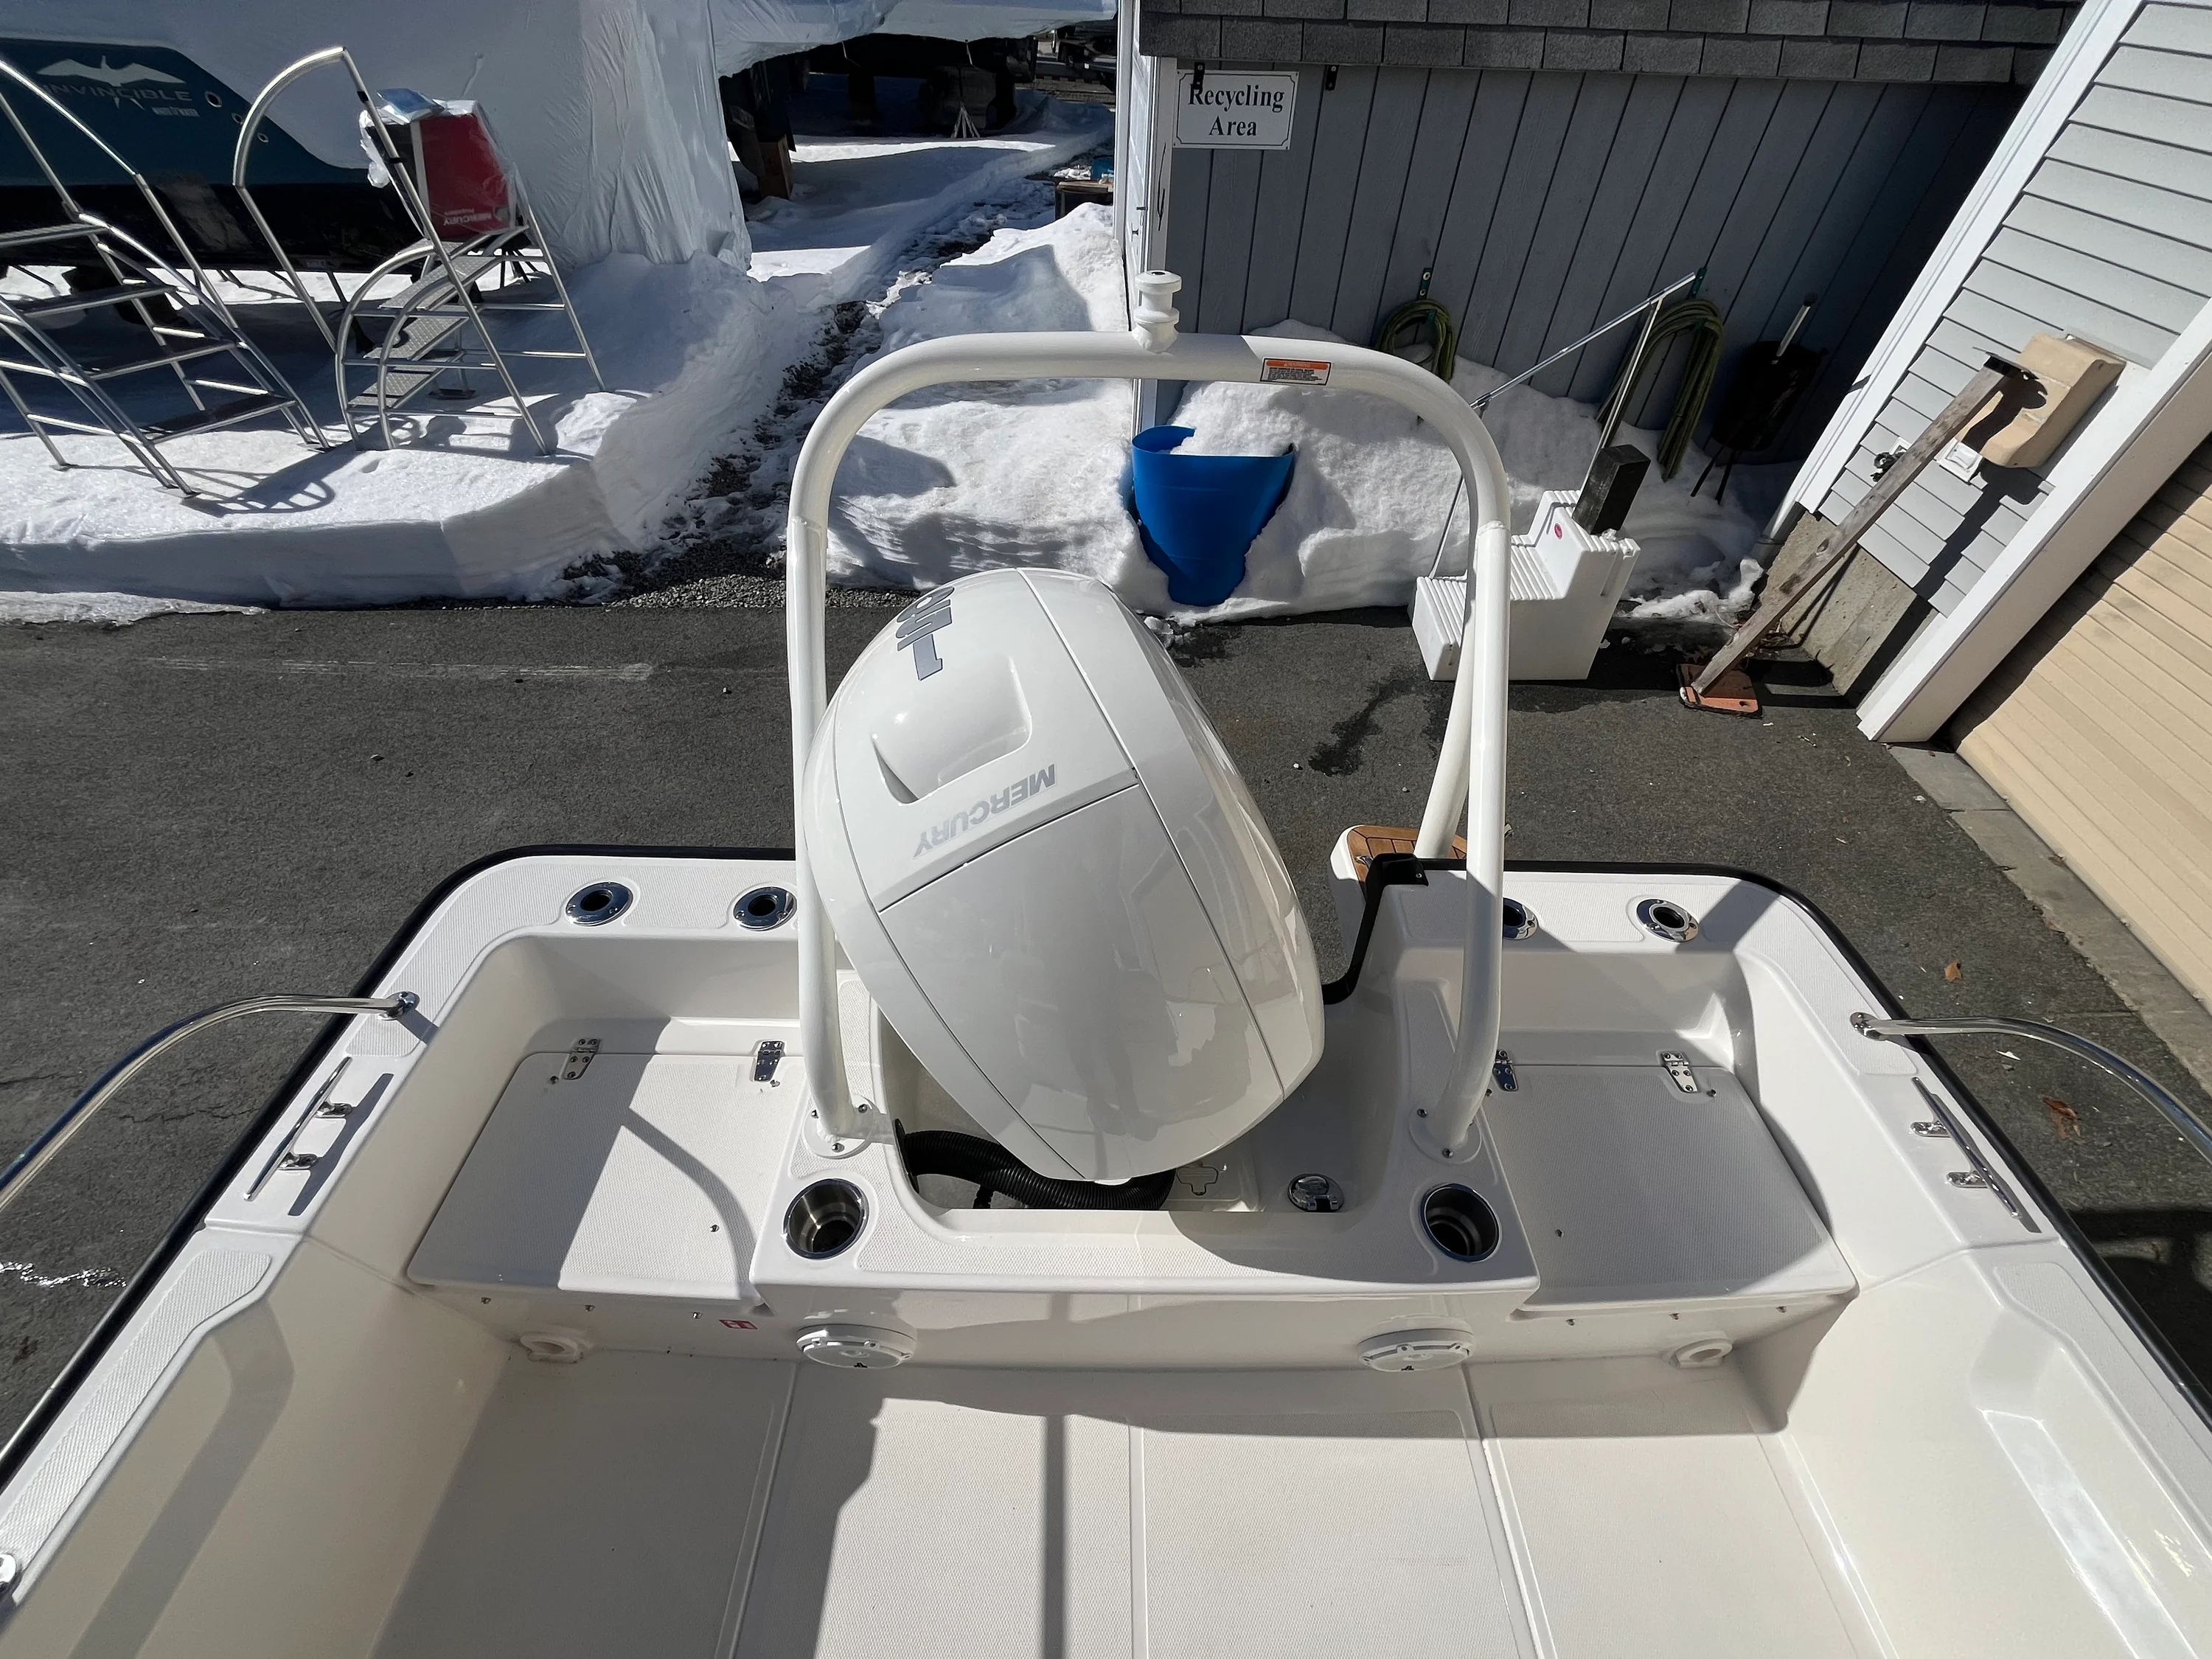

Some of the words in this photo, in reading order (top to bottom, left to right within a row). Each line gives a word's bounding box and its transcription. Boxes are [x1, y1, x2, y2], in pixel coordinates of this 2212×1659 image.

[1188, 83, 1285, 113] Recycling
[1208, 116, 1257, 136] Area
[913, 763, 1057, 859] MERCURY
